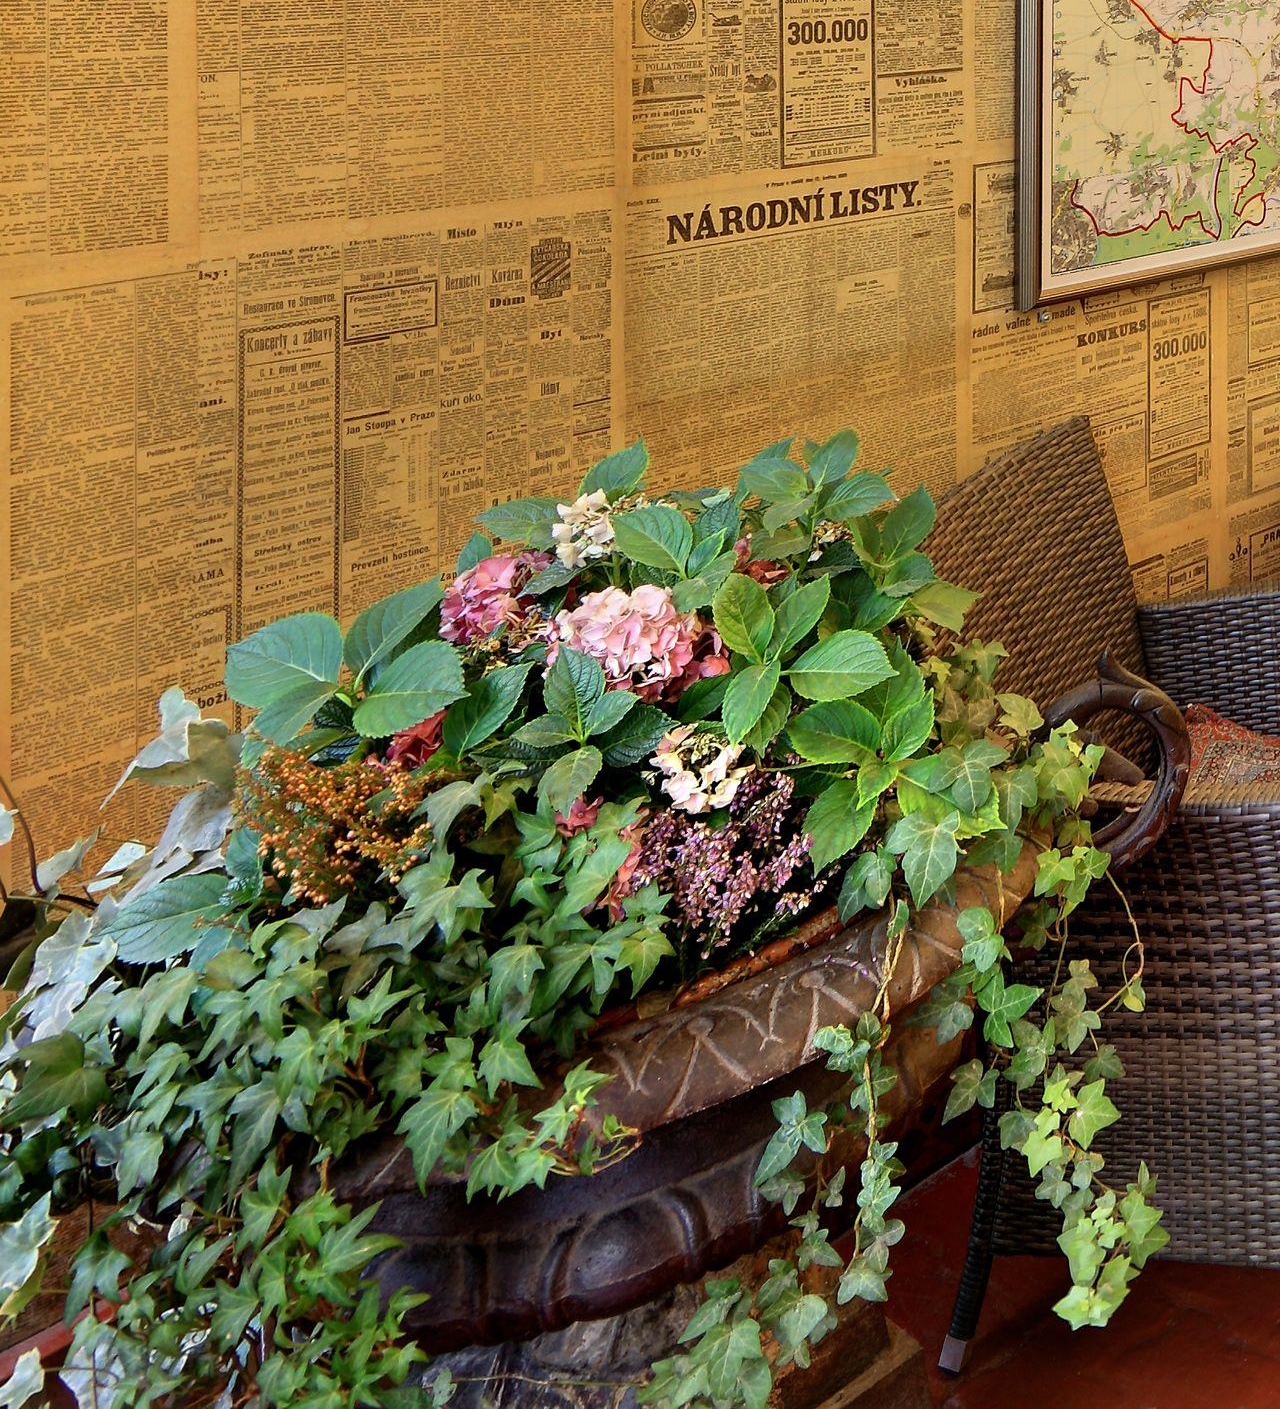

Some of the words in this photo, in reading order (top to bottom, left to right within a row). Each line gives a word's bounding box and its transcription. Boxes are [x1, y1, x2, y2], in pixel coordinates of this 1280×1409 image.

[787, 18, 869, 46] 300.000
[645, 60, 704, 72] POLLATSCHEK
[666, 187, 825, 246] NÁRODNÍ
[829, 180, 923, 220] LISTY.
[1076, 318, 1148, 348] KONKURS
[1153, 330, 1208, 362] 300.000
